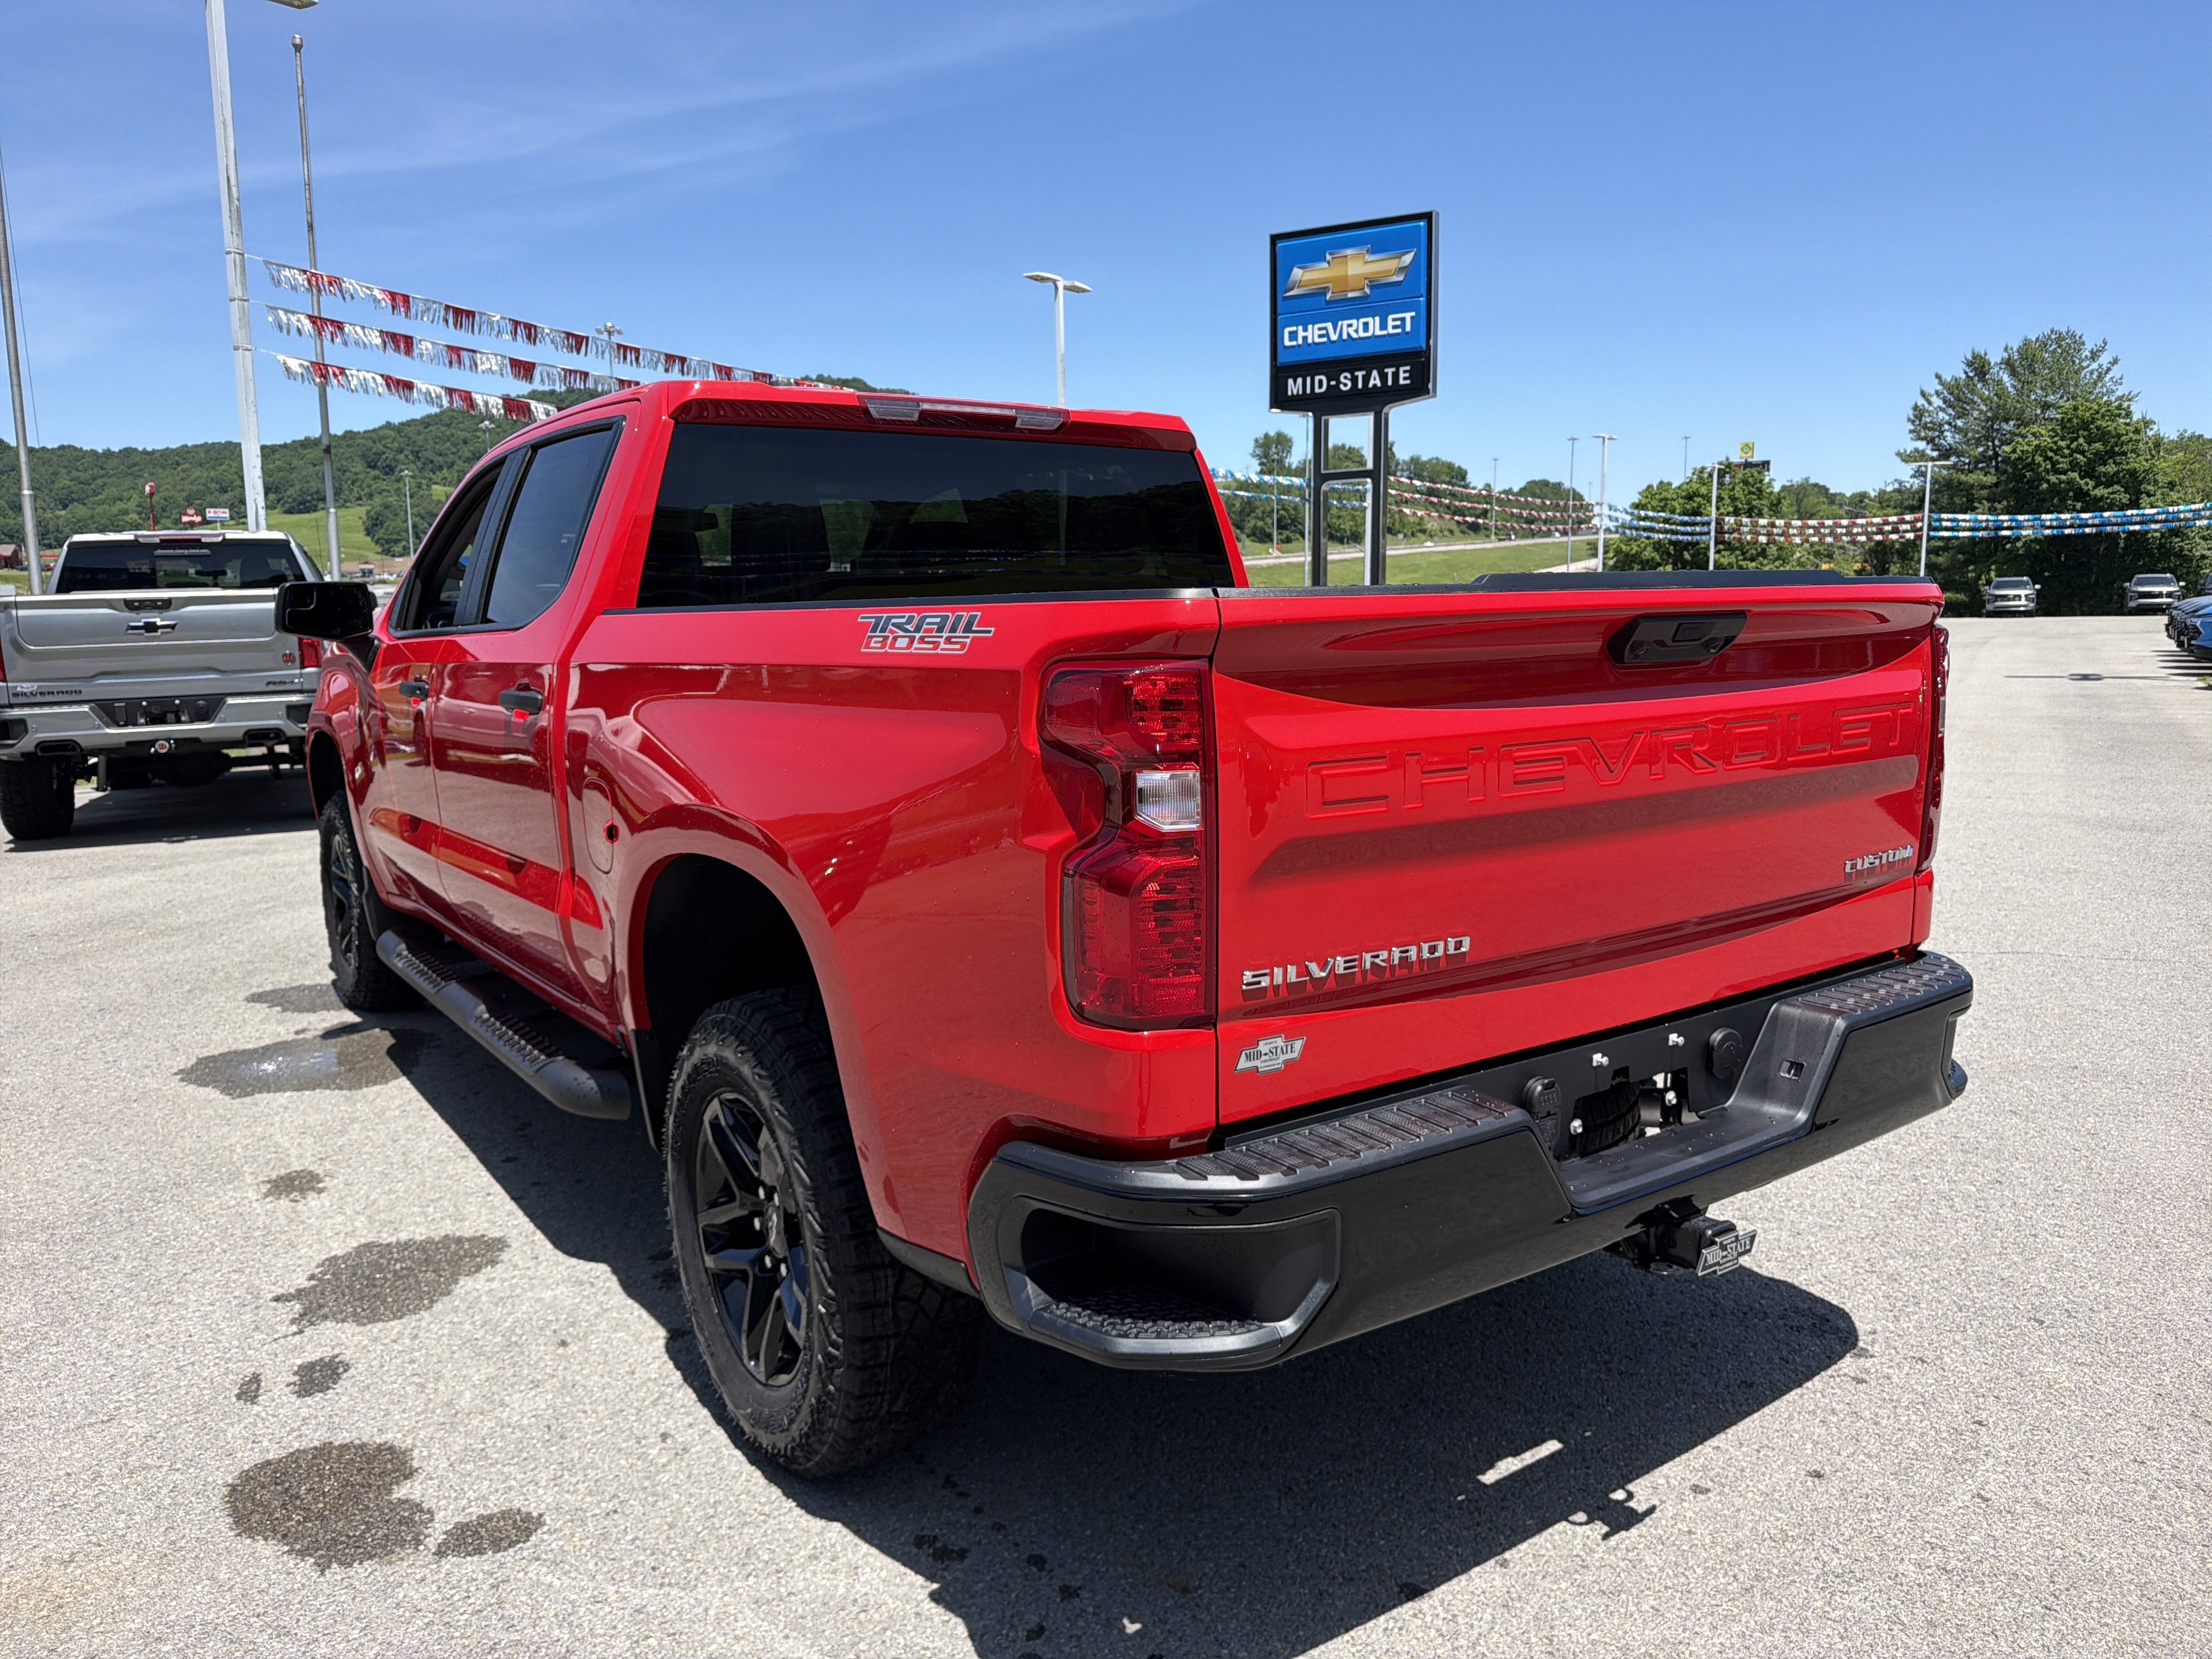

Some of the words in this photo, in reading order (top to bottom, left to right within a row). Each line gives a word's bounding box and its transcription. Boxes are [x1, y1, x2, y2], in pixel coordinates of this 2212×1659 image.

[1284, 312, 1416, 347] CHEVROLET
[1287, 366, 1412, 396] MID-STATE
[857, 611, 995, 637] TRAIL
[860, 635, 972, 654] BOSS
[11, 689, 82, 697] SILVERADO
[1306, 703, 1913, 819] CHEVROLET
[1845, 845, 1914, 873] CUSTOM
[1242, 935, 1470, 990] SILVERADO
[1244, 1042, 1296, 1063] MID-STATE
[1705, 1237, 1751, 1267] MID-STATE
